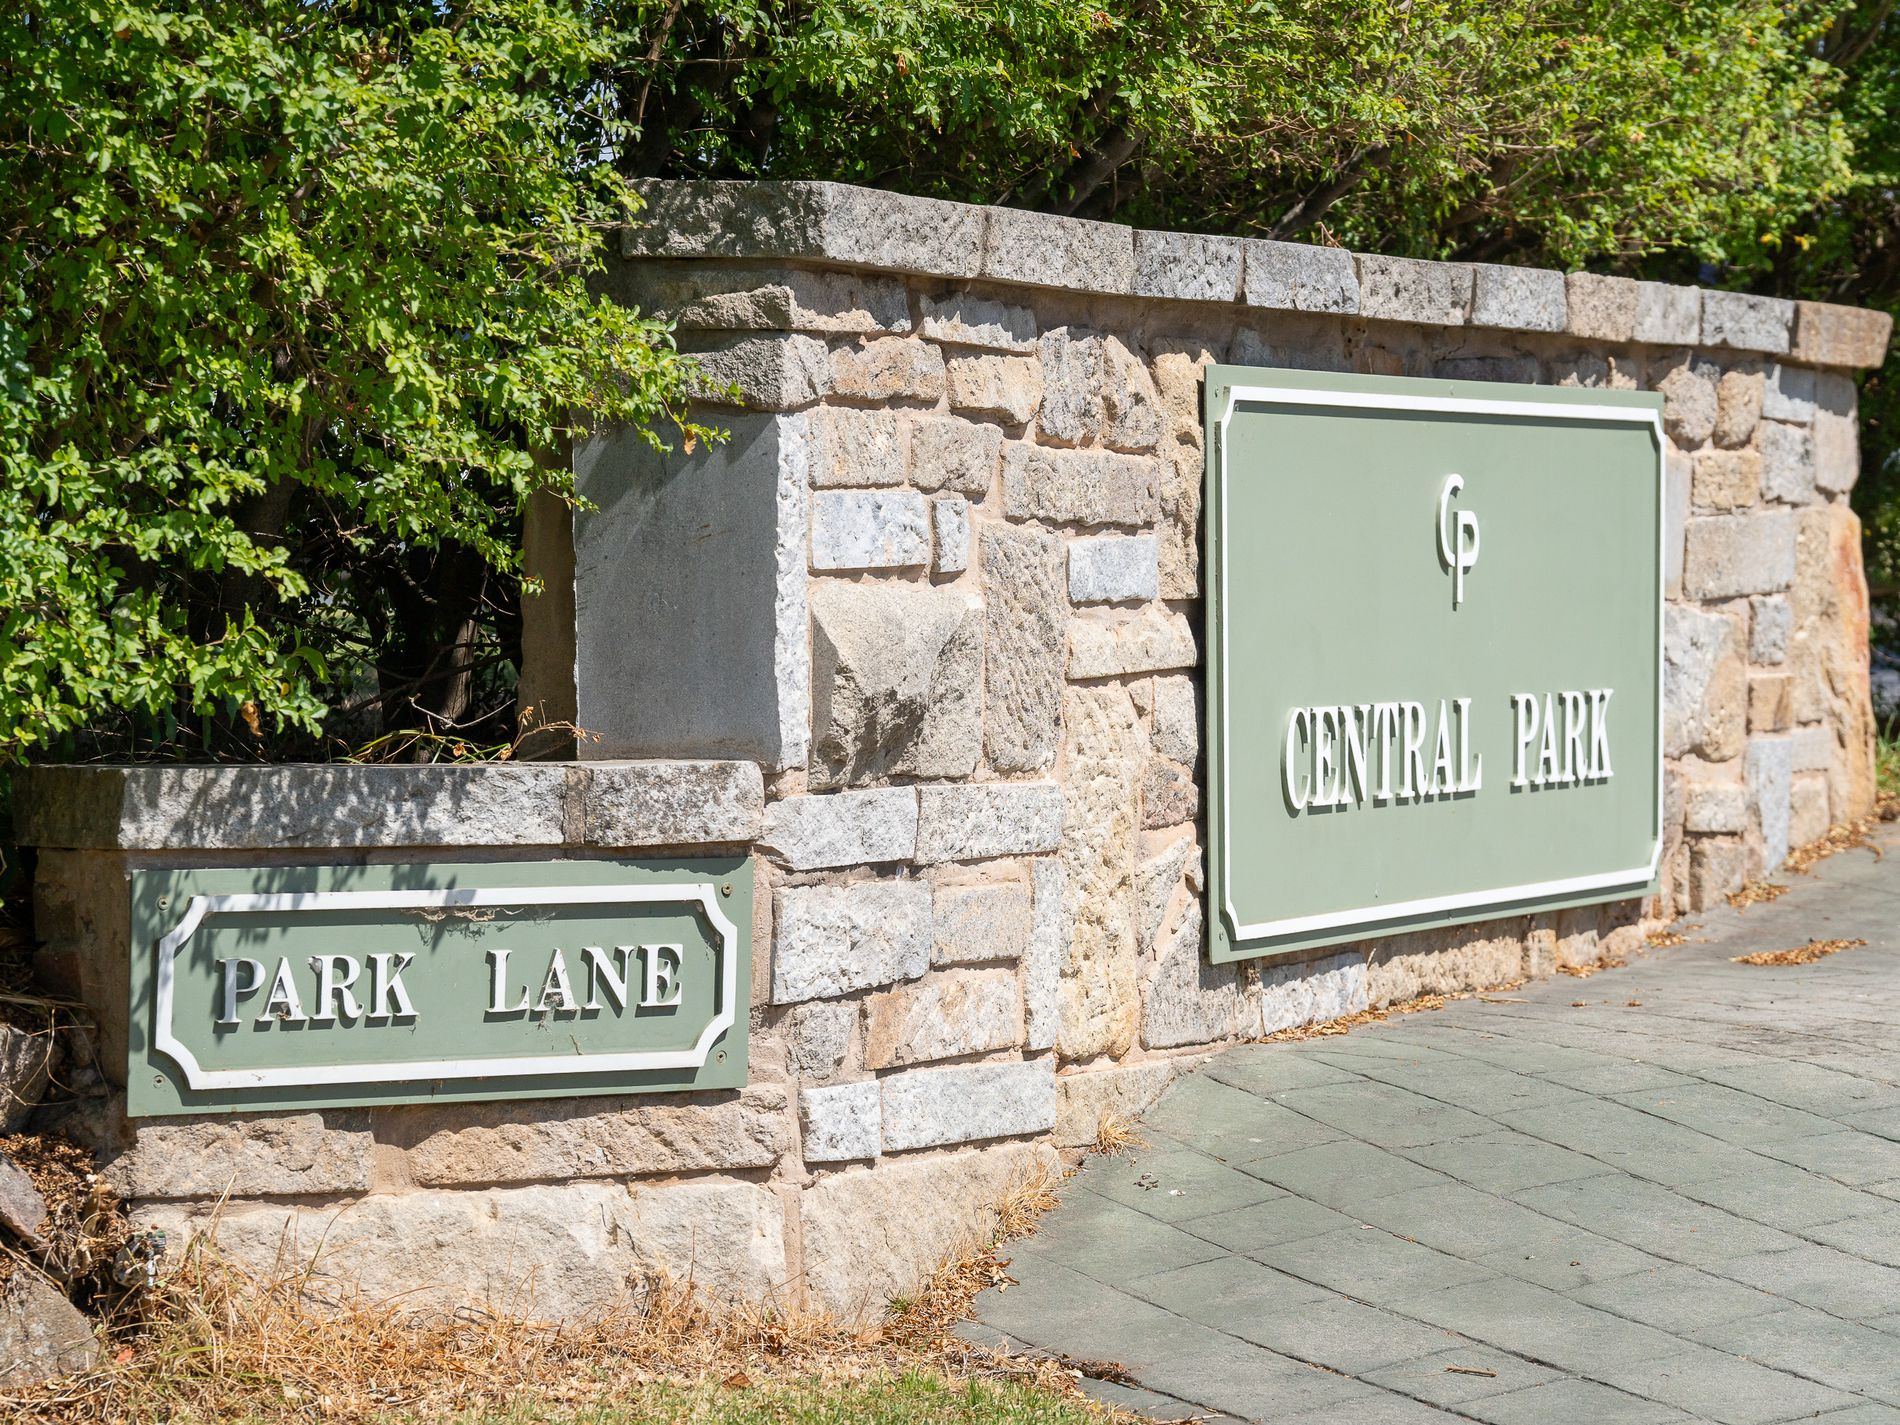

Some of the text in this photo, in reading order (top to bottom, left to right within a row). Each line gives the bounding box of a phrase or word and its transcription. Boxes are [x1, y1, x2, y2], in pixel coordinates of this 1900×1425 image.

[1284, 688, 1614, 810] CENTRAL PARK
[216, 943, 684, 1026] PARK LANE
